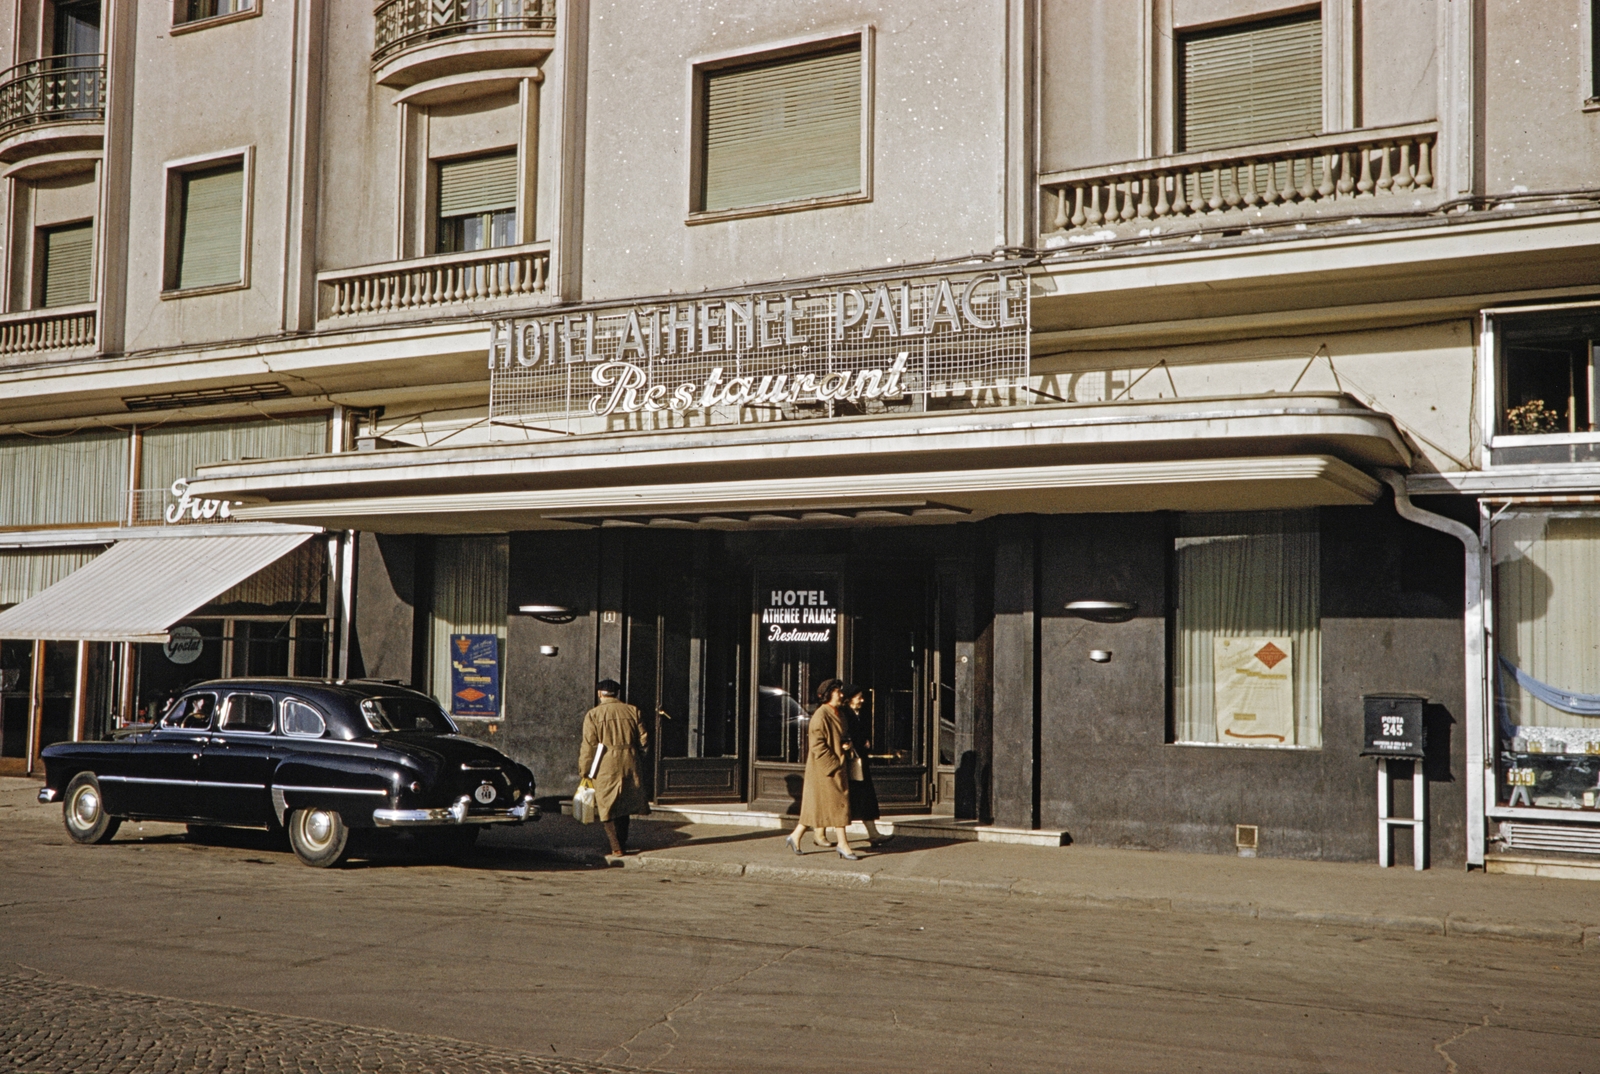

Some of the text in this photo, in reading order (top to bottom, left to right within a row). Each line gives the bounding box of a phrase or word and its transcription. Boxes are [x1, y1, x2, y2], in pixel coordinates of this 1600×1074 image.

[487, 267, 1025, 370] HOTEL ATHENEE PALACE
[588, 351, 909, 417] Restaurant
[771, 589, 828, 606] HOTEL
[802, 607, 837, 624] PALACE
[768, 624, 830, 642] Restaurant
[1382, 723, 1404, 736] 245
